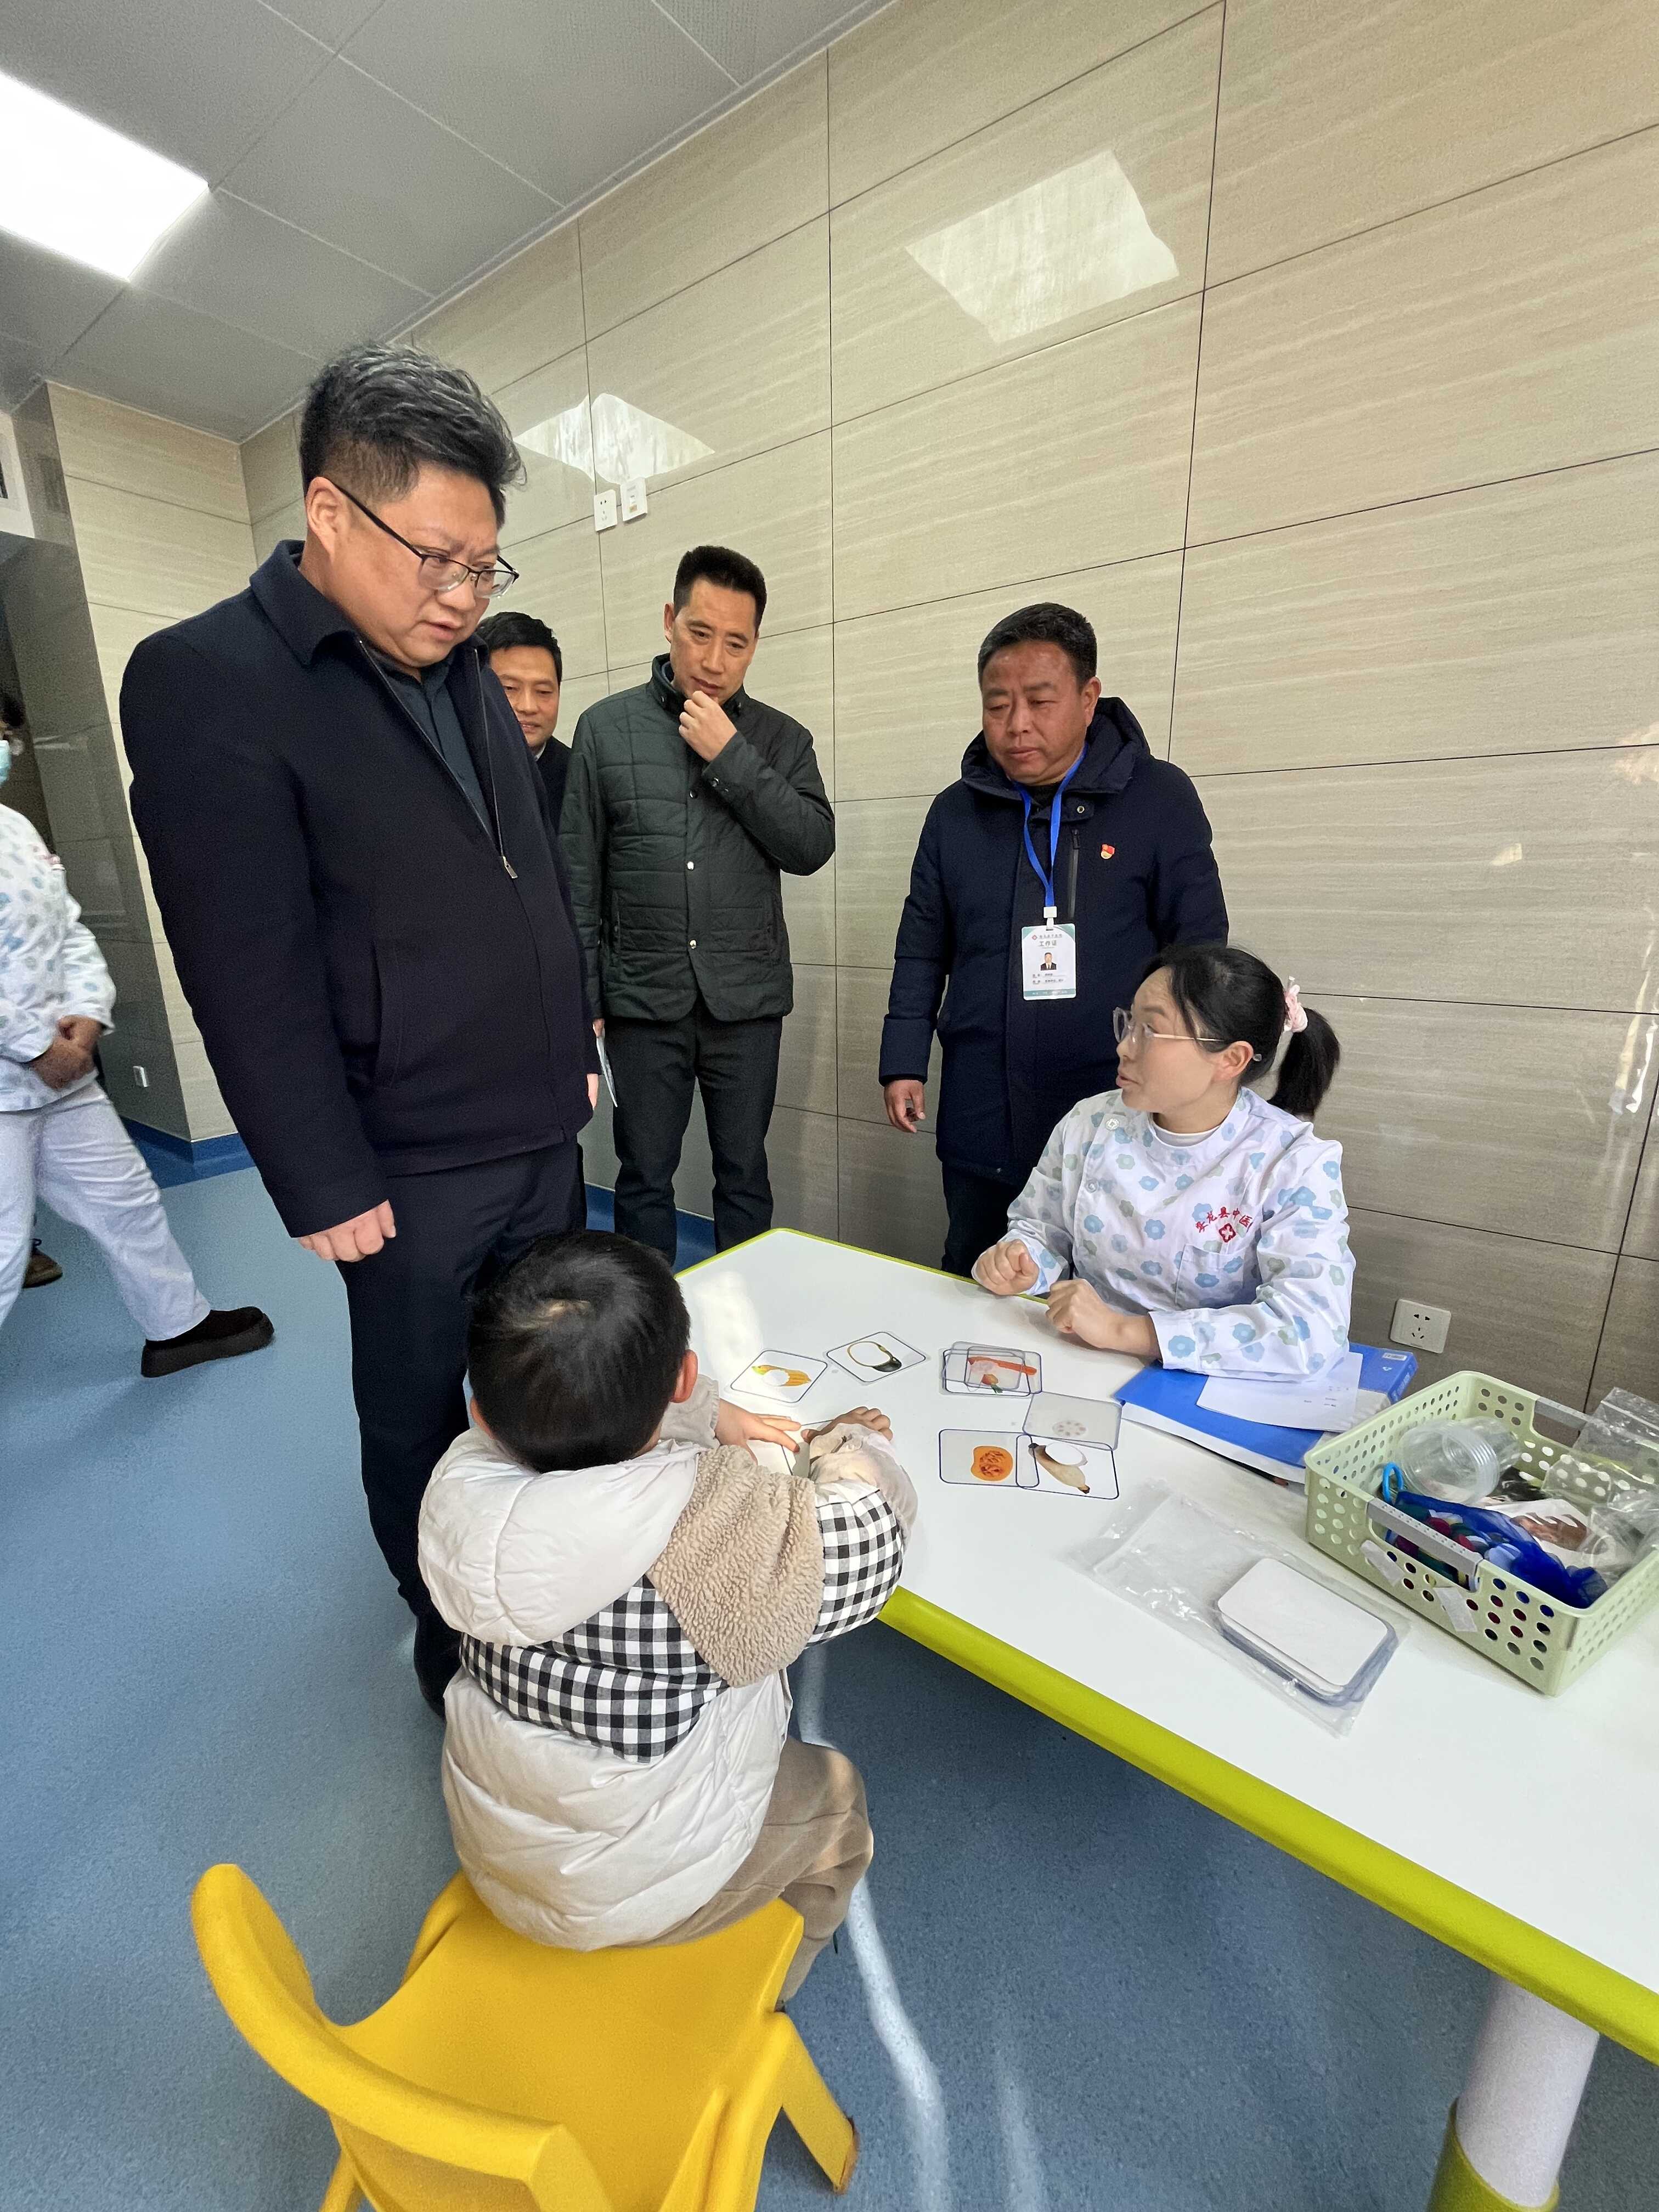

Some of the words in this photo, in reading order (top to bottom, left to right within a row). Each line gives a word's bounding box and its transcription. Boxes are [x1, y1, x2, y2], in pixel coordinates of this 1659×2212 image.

[1196, 1206, 1254, 1233] 安龙县中医
